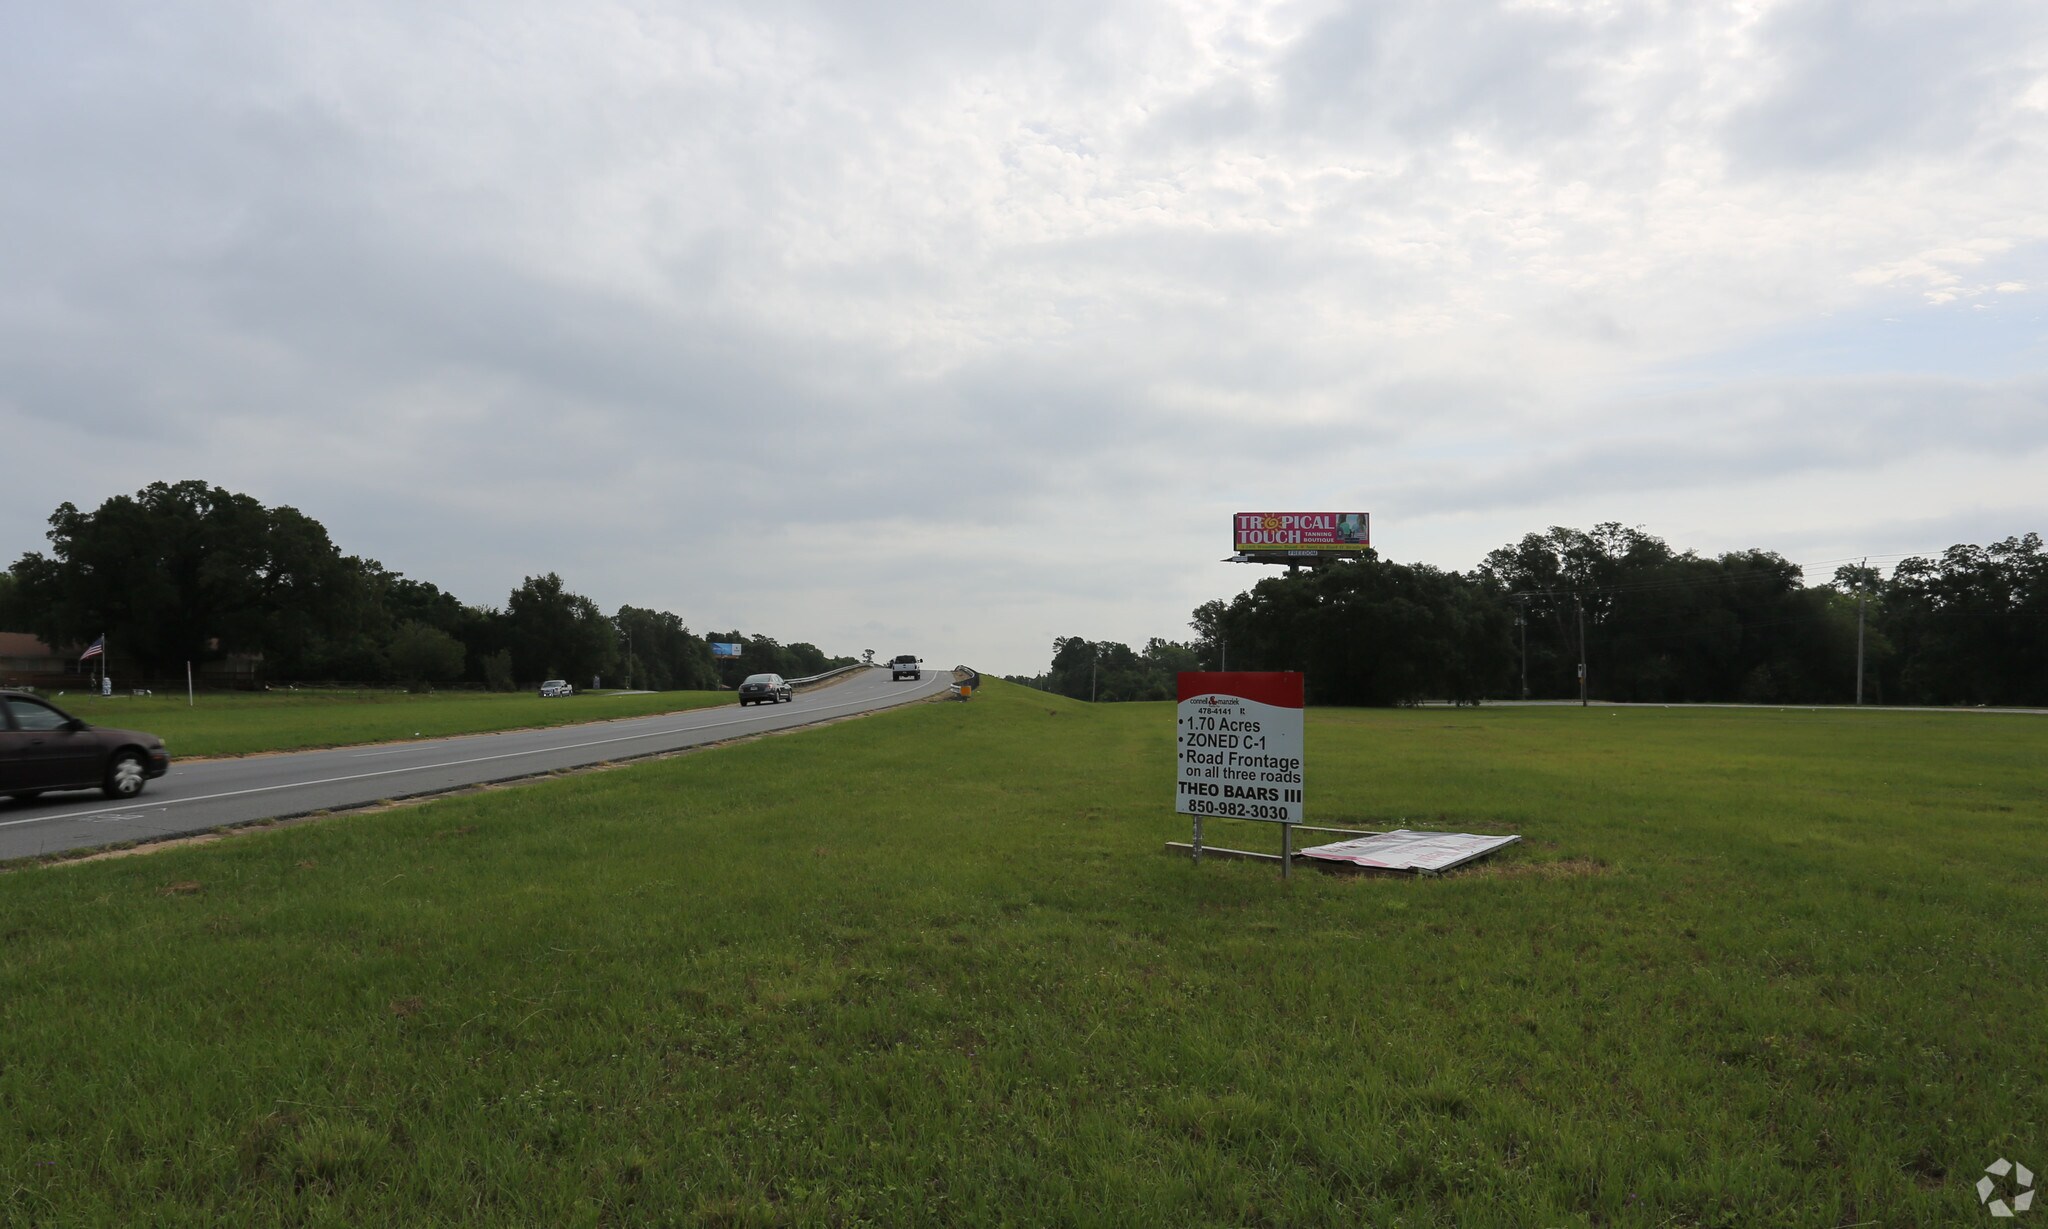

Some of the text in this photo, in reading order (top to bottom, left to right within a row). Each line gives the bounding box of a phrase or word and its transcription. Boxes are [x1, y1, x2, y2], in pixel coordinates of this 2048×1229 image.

[1238, 515, 1335, 530] TROPICAL
[1238, 530, 1300, 543] TOUCH
[1187, 716, 1260, 732] 1.70 Acres
[1187, 733, 1266, 750] ZONED C-1
[1187, 750, 1300, 772] Road Frontage
[1186, 766, 1301, 783] on all three roads
[1179, 782, 1301, 803] THEO BAARS III
[1188, 799, 1288, 820] 850-982-3030
